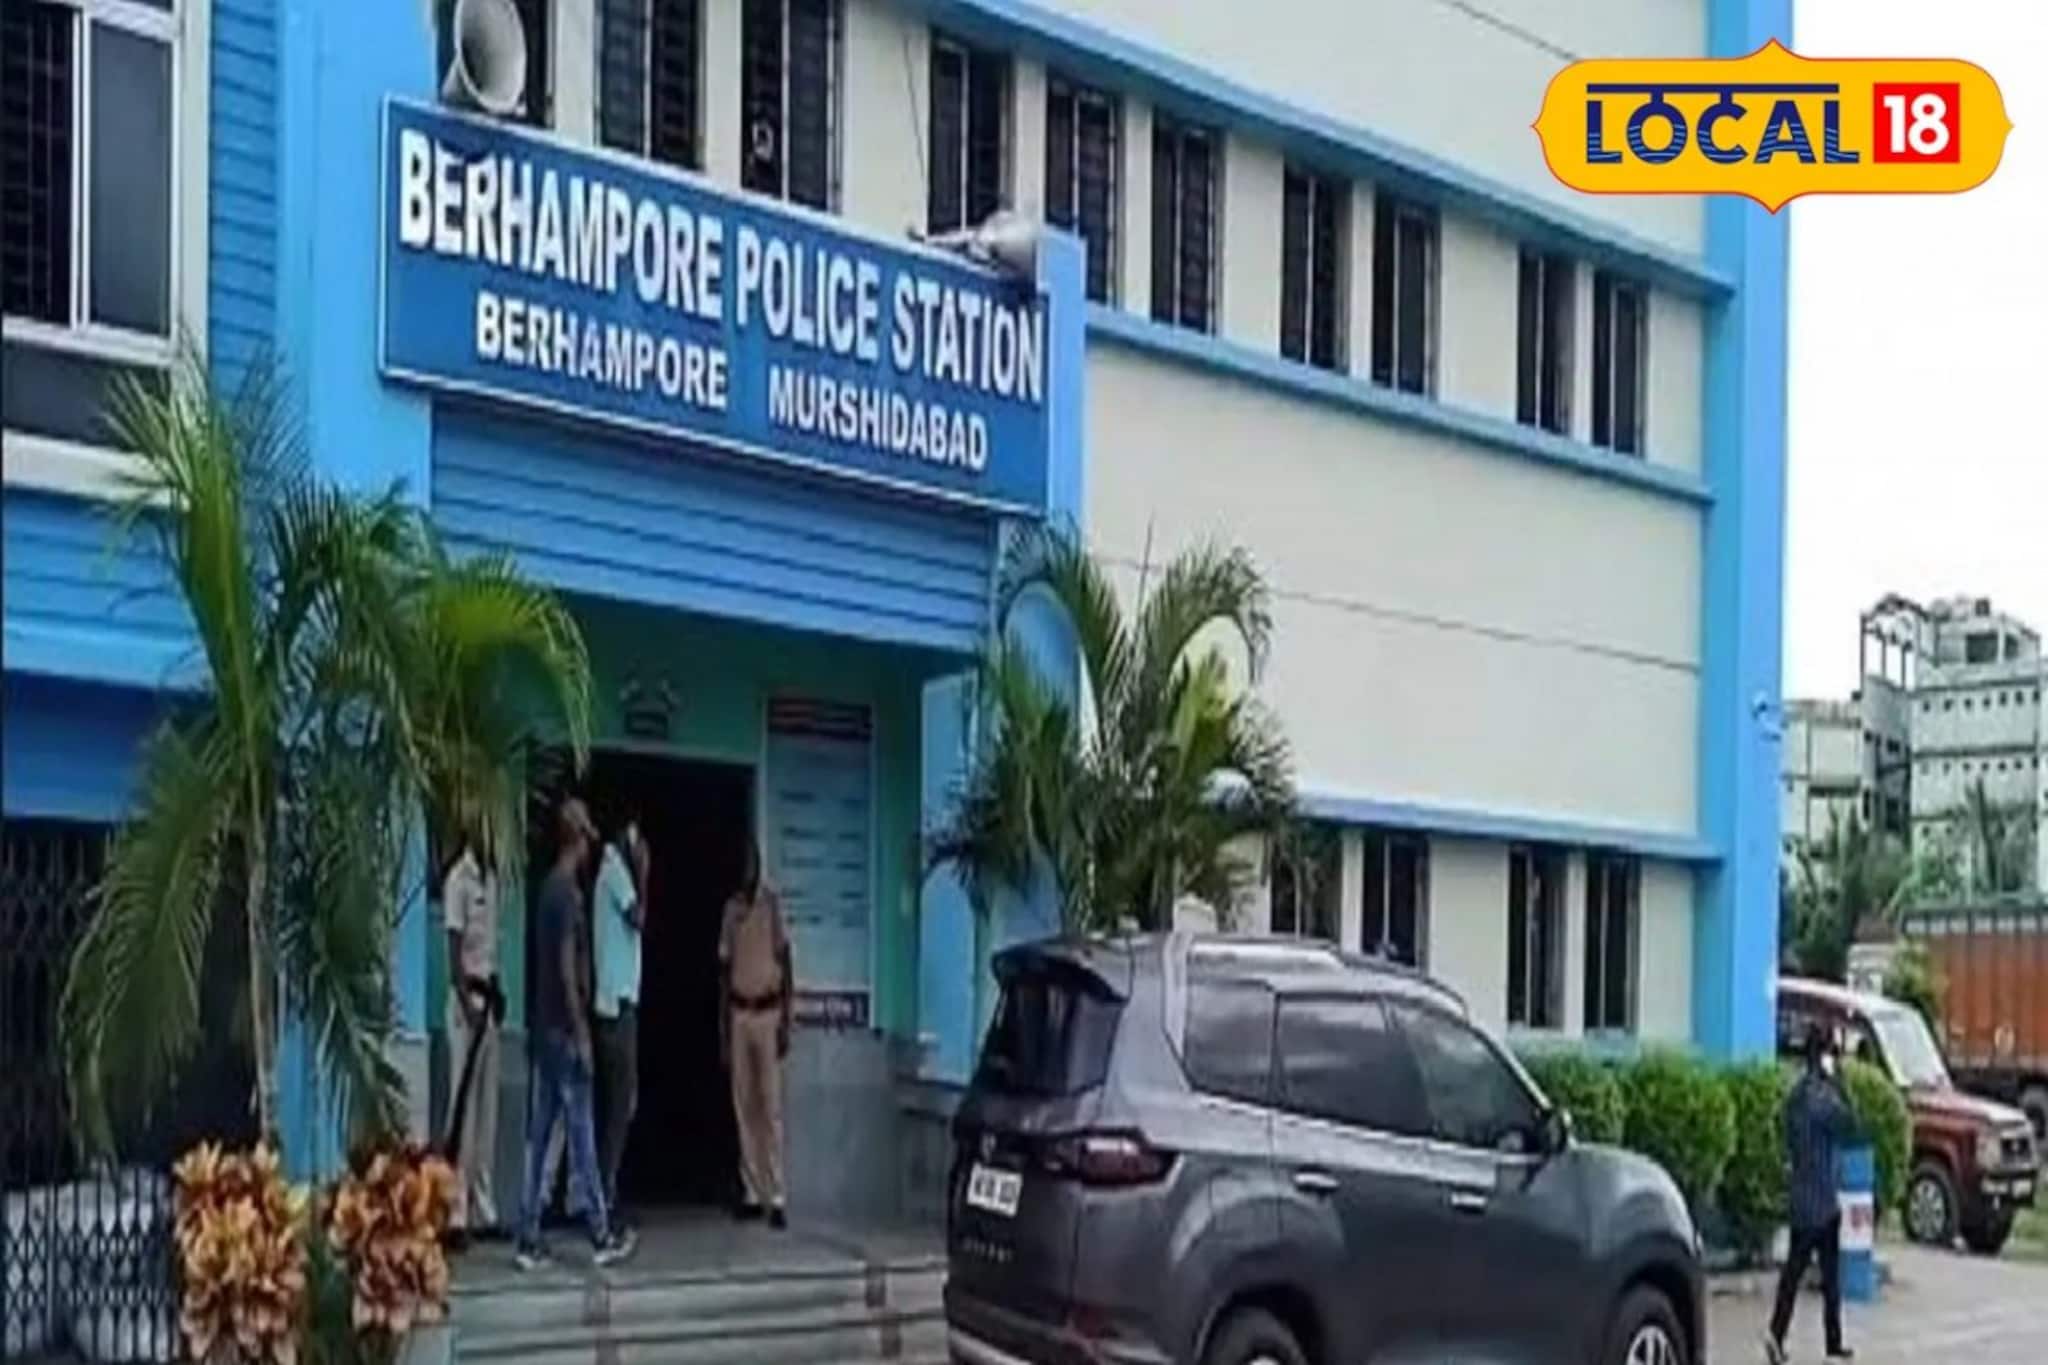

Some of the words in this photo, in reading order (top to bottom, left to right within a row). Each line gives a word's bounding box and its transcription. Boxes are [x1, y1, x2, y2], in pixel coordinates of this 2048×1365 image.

[399, 128, 723, 322] BERHAMPORE
[736, 226, 880, 361] POLICE
[892, 274, 1042, 401] STATION
[476, 294, 727, 409] BERHAMPORE
[768, 368, 988, 472] MURSHIDABAD
